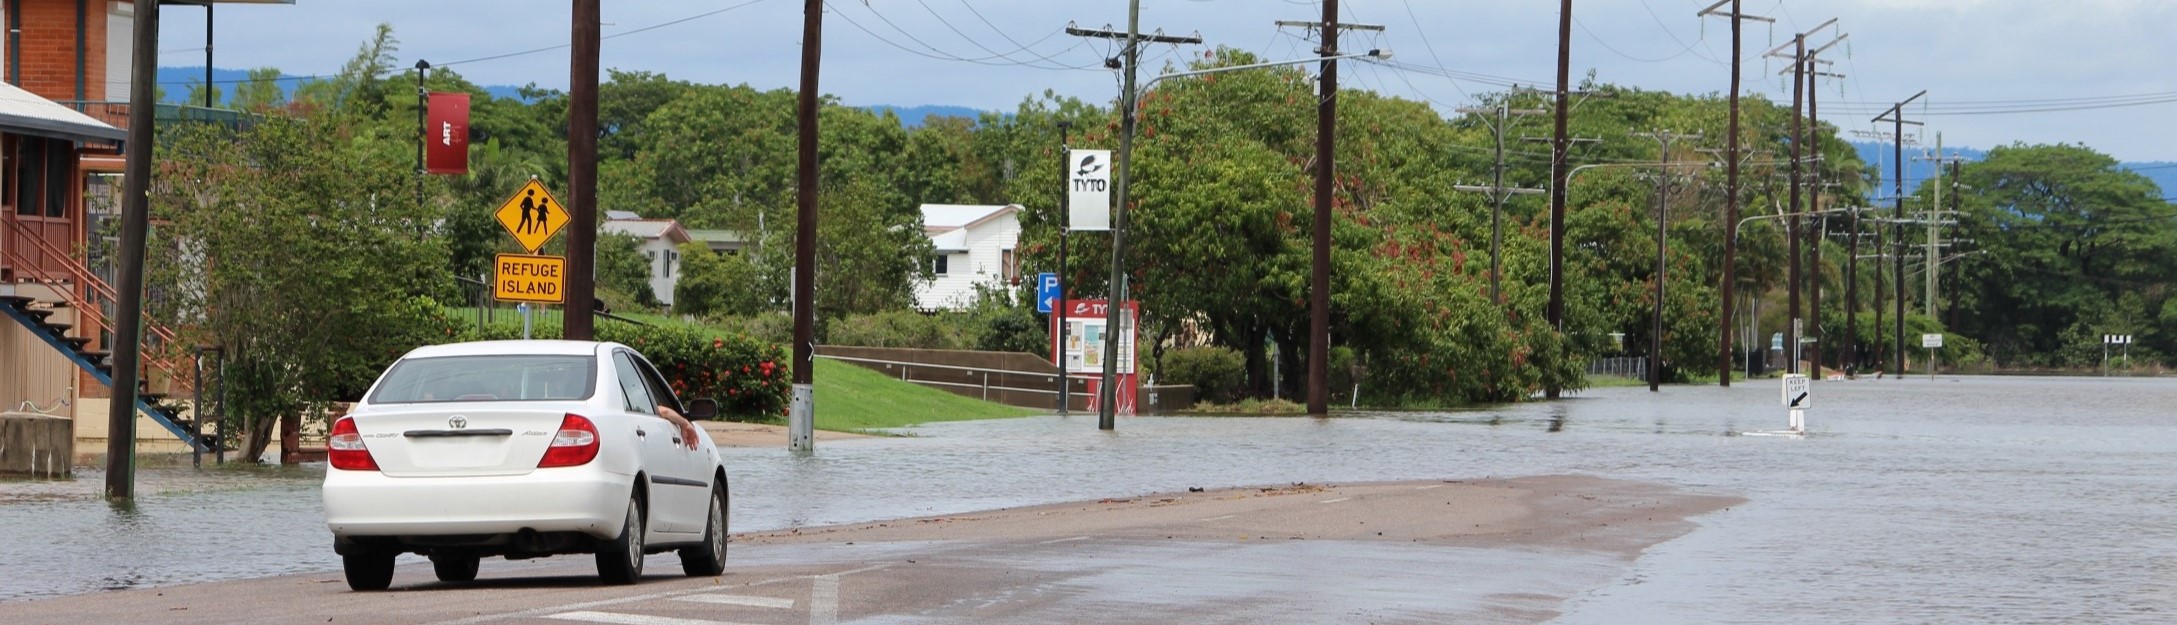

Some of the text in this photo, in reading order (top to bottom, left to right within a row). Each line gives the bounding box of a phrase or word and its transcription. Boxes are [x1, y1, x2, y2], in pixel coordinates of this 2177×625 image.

[442, 120, 451, 147] ART
[1072, 178, 1107, 193] TYTO
[501, 262, 559, 278] REFUGE
[502, 280, 557, 295] ISLAND
[1046, 277, 1058, 293] P
